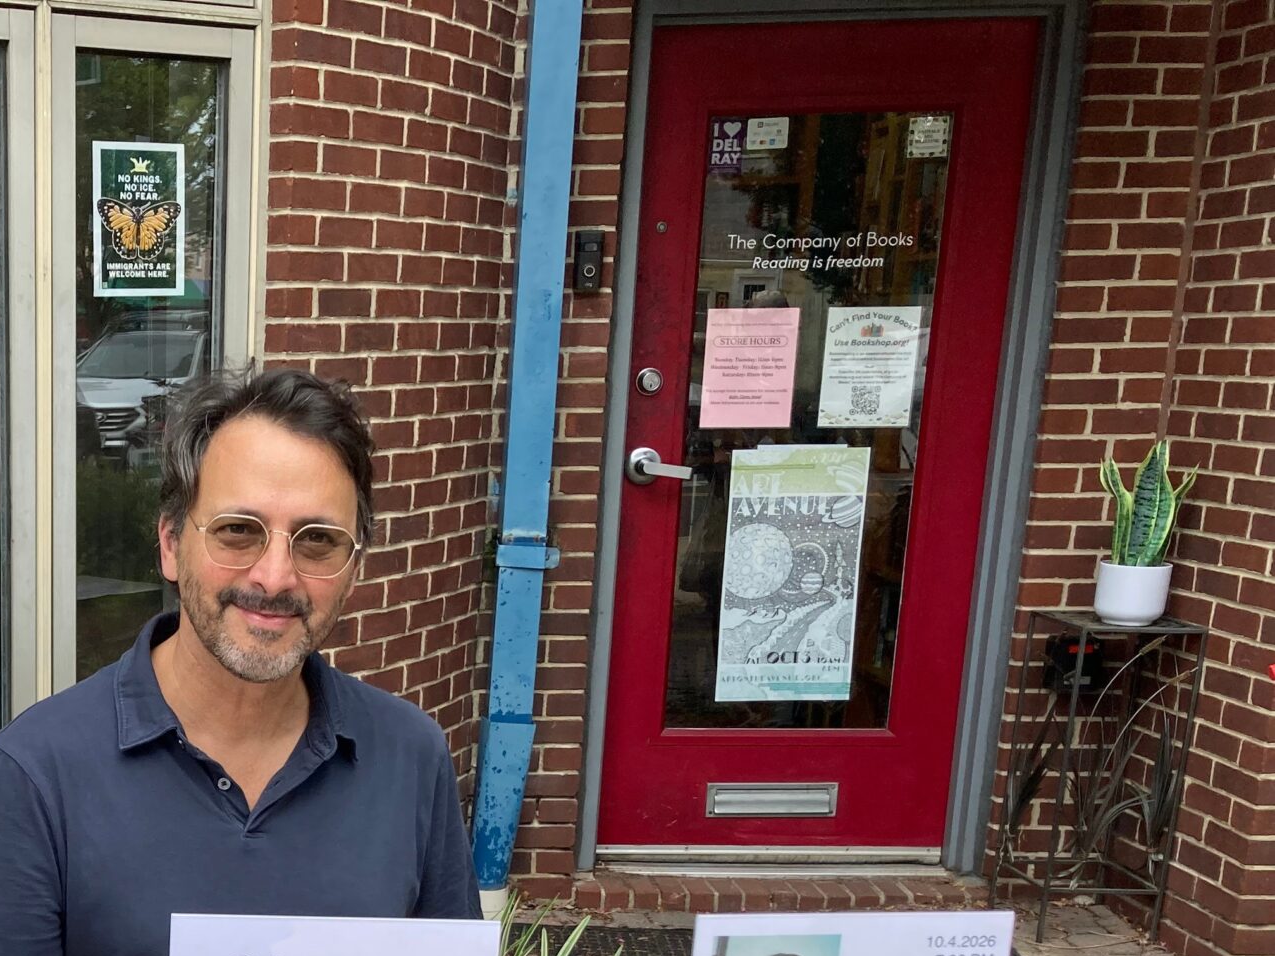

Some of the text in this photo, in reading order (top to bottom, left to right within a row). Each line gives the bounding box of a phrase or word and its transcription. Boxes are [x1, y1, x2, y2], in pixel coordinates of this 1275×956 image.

[714, 122, 719, 137] I
[712, 138, 741, 152] DEL
[711, 152, 741, 164] RAY
[134, 175, 162, 183] KINGS.
[140, 184, 156, 192] ICE.
[135, 192, 160, 200] FEAR.
[728, 231, 914, 251] The Company of Books
[752, 255, 884, 271] Reading is freedom
[109, 270, 169, 278] WELCOME HERE.
[830, 312, 917, 333] Can't Find Your Book?
[750, 337, 781, 345] HOURS
[851, 339, 909, 347] Bookshop.org!
[734, 473, 785, 497] ART
[735, 495, 831, 517] AVENUE
[927, 935, 997, 949] 10.4.2026
